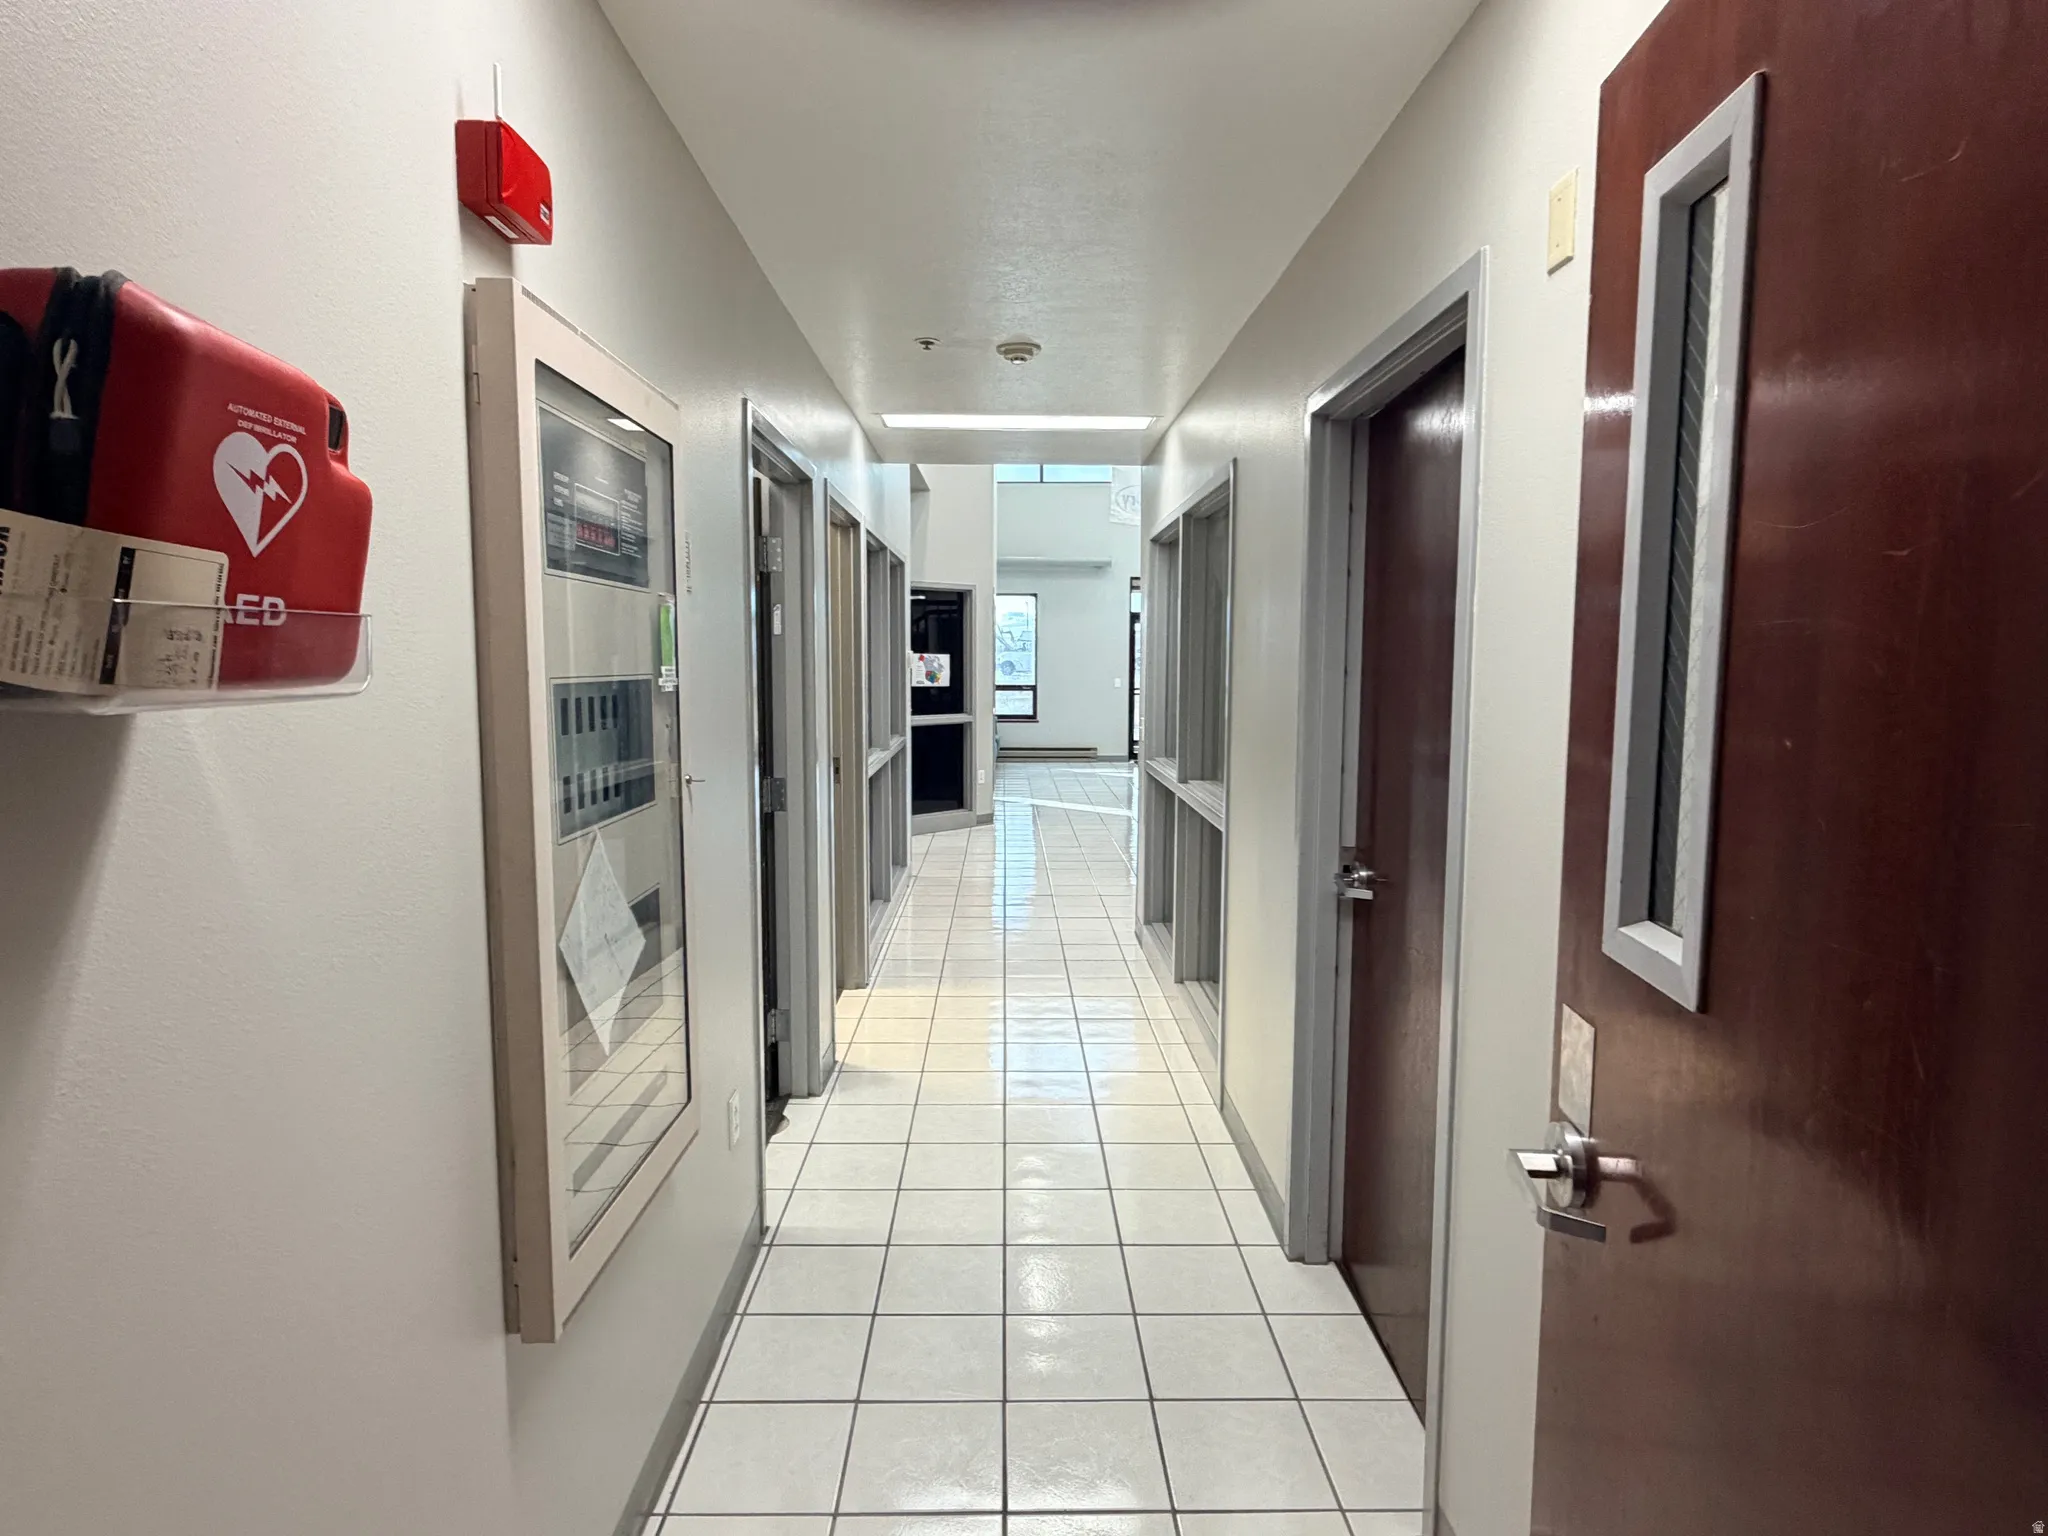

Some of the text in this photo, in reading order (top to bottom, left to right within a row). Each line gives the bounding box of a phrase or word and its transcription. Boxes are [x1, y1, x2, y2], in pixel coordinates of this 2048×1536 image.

[227, 402, 306, 435] AUTOMATED EXTERNAL
[237, 419, 297, 443] DEFIBRILLATOR
